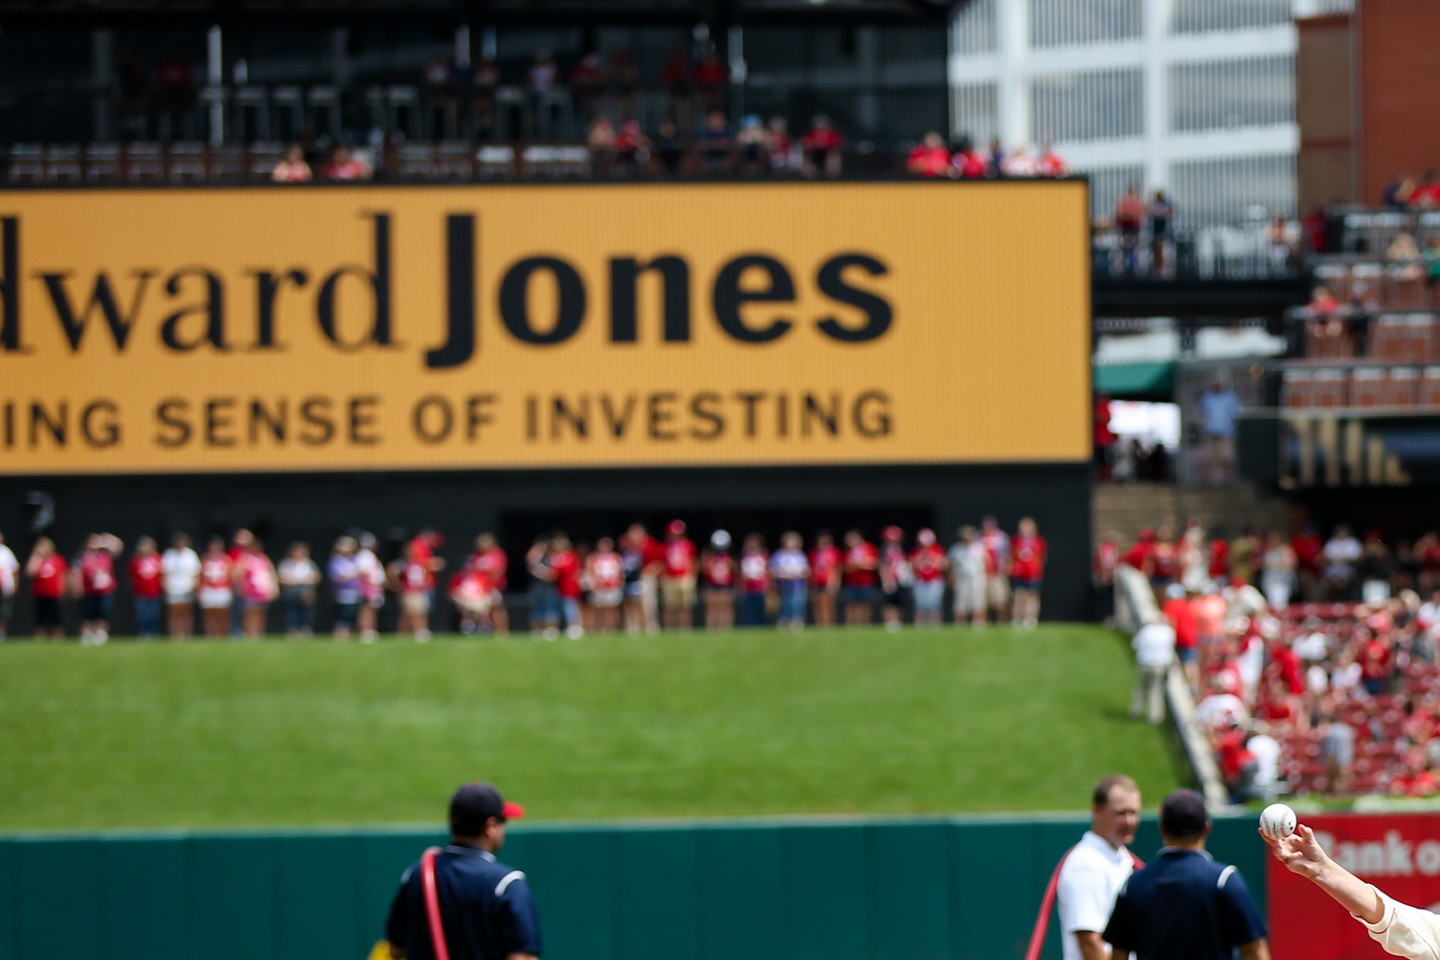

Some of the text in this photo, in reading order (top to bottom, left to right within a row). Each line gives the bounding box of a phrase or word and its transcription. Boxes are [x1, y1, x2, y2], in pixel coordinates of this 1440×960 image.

[421, 211, 896, 372] Jones
[153, 397, 384, 447] SENSE
[410, 396, 498, 444] OF
[524, 390, 894, 443] INVESTING
